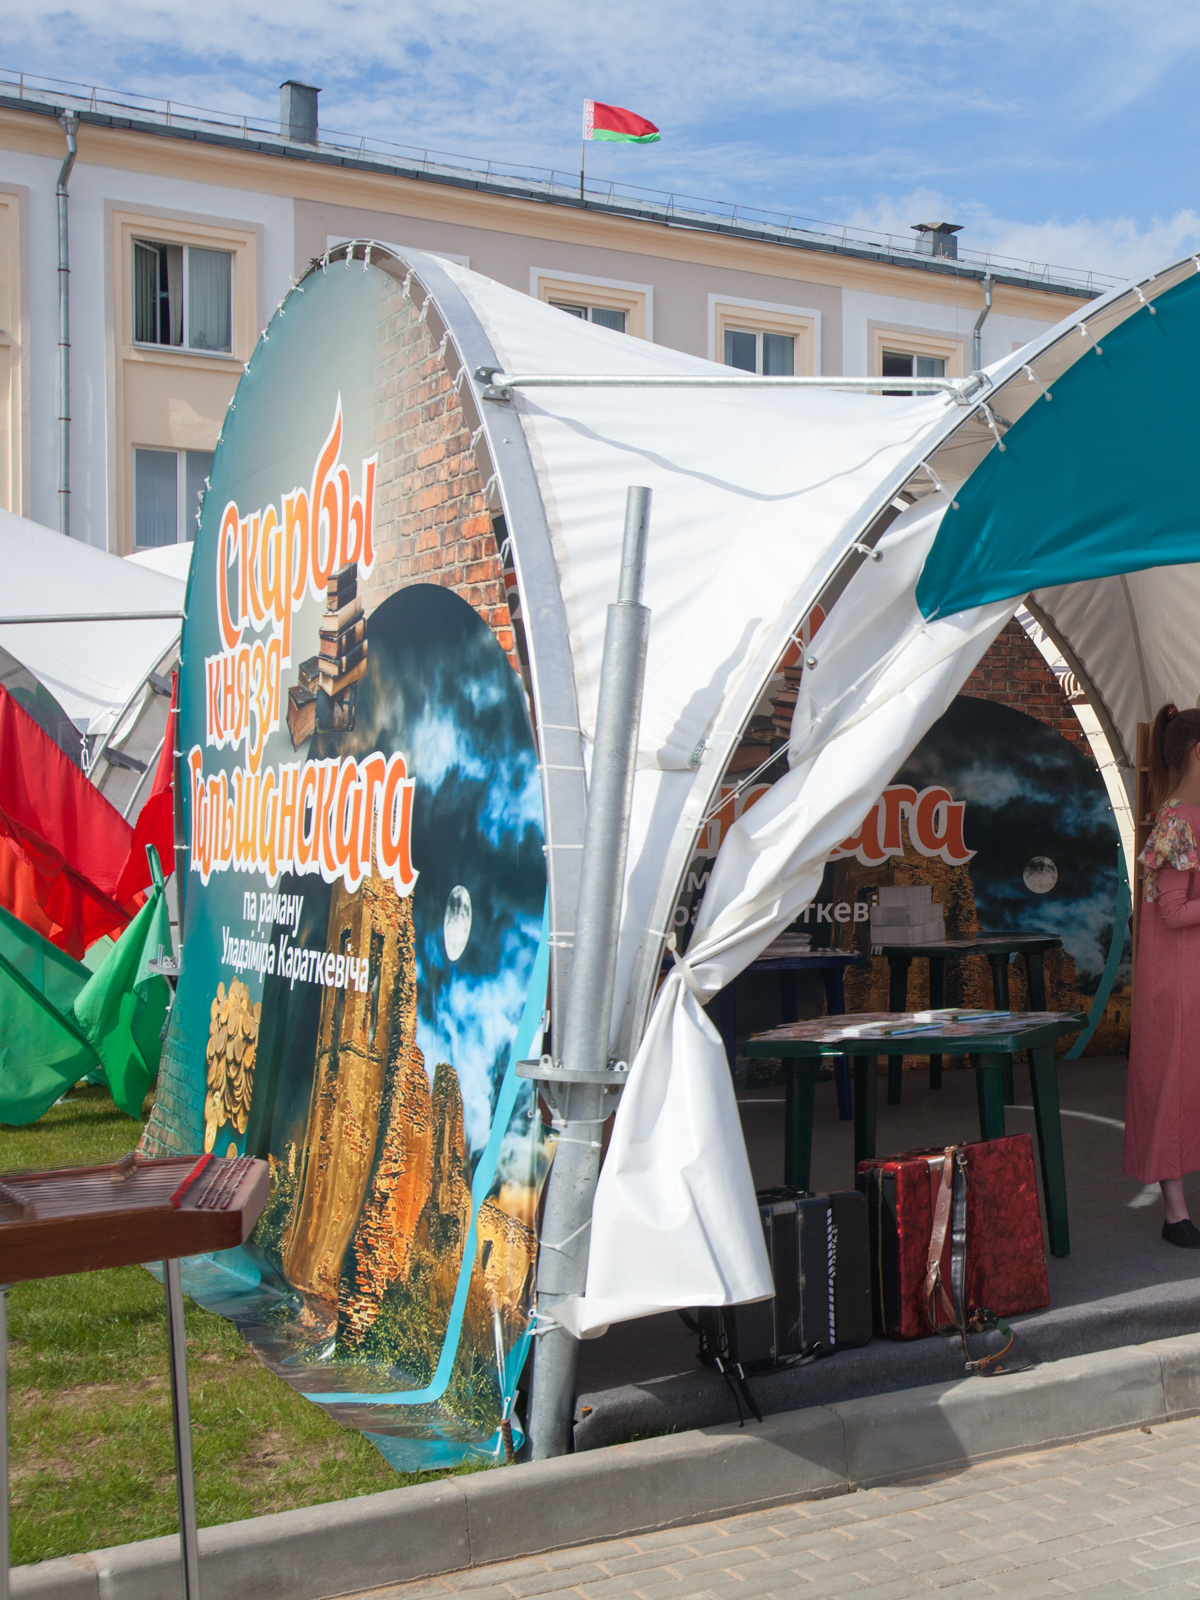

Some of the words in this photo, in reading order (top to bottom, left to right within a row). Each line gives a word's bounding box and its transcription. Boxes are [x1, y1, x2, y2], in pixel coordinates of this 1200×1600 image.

[216, 391, 378, 670] Скарбы
[188, 744, 419, 897] Гальшанскага
[221, 926, 276, 984] Уладзіміра
[276, 933, 370, 993] Караткевіча
[242, 891, 257, 921] па
[257, 891, 304, 938] раману
